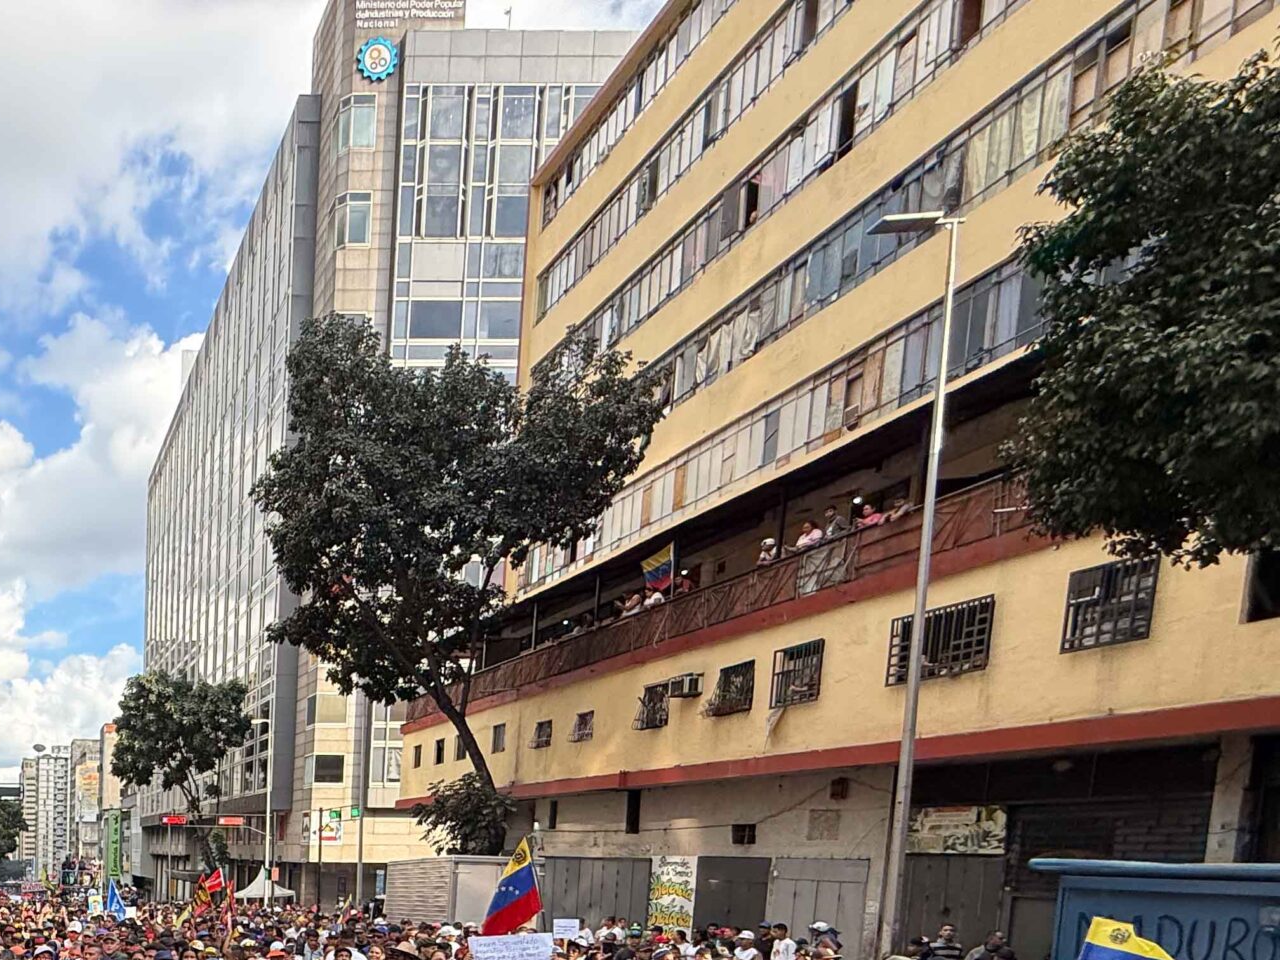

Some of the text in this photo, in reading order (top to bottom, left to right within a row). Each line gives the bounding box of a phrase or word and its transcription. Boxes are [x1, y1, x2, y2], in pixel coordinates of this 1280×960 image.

[356, 0, 395, 8] Ministerio
[410, 0, 433, 8] Poder
[434, 0, 464, 9] Popular
[357, 18, 399, 28] Nacional
